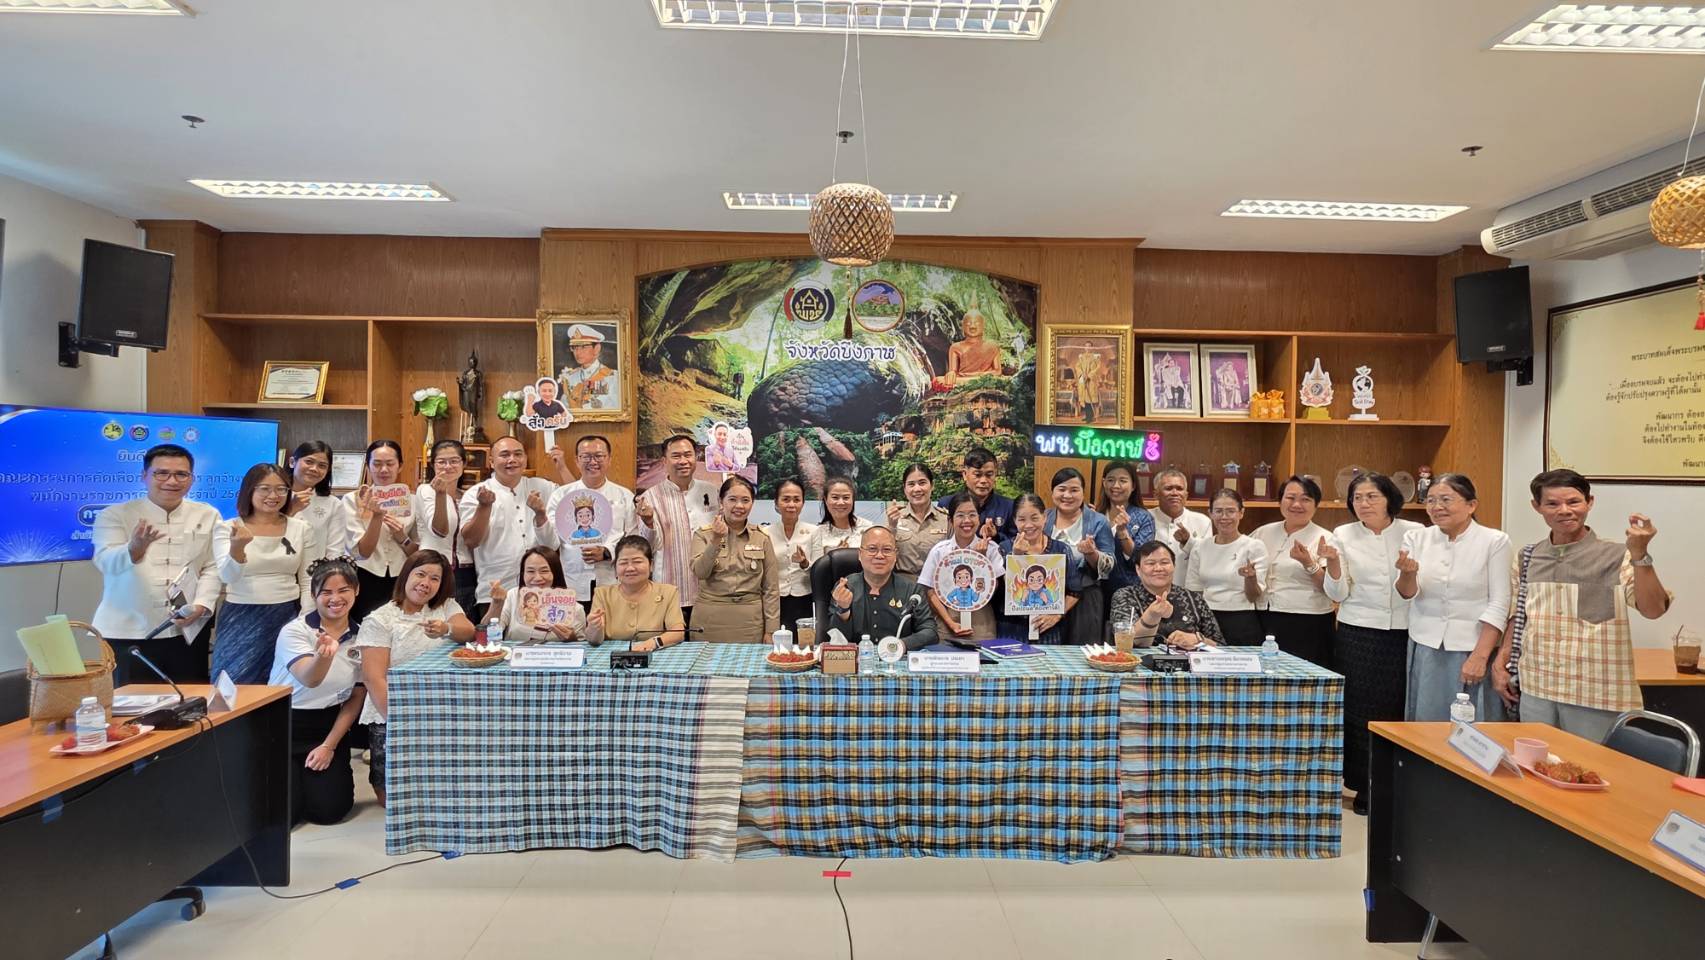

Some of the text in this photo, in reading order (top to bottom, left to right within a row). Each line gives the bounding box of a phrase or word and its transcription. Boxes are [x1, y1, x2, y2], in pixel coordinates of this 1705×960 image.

[786, 339, 896, 360] จังหวัดบึงกาฬ
